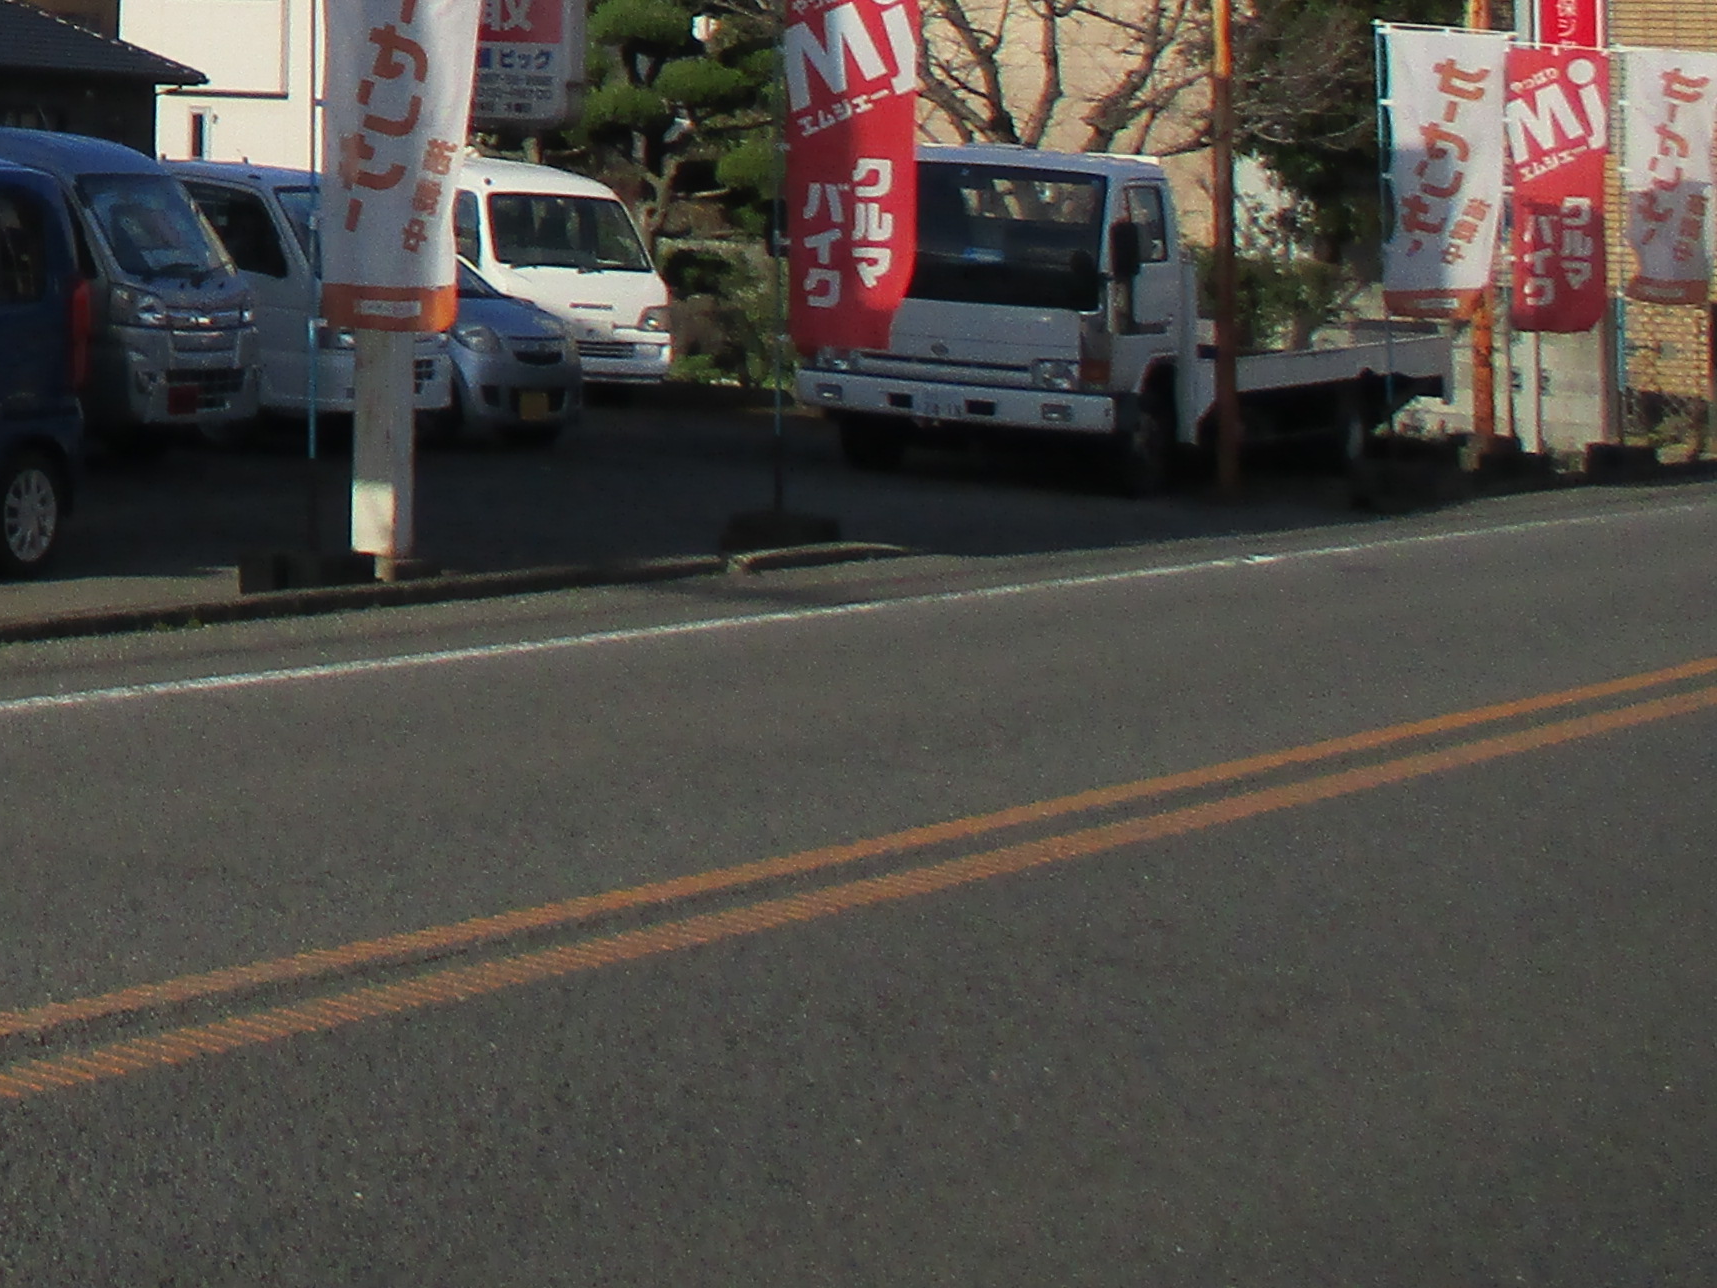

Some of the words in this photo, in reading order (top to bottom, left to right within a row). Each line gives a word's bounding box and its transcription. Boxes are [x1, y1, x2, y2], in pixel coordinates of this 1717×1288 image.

[802, 181, 851, 309] バイク
[851, 157, 894, 289] クルマ
[1522, 213, 1561, 307] バイク
[1560, 196, 1594, 291] クルマ
